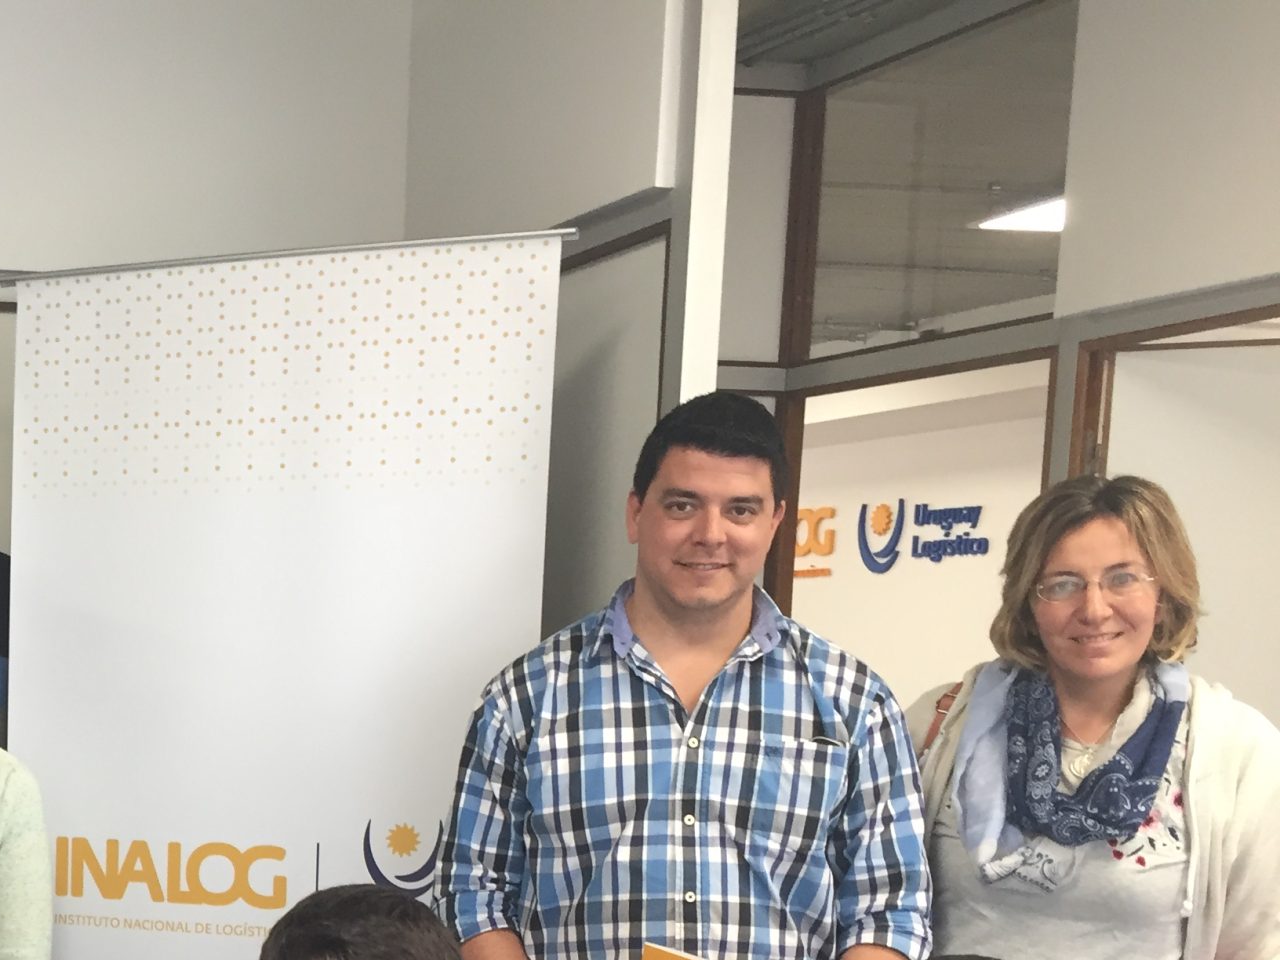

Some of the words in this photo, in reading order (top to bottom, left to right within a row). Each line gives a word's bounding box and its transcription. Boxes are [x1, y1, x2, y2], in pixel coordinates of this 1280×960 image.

[913, 504, 983, 530] Uruguay
[55, 836, 288, 909] INALOG
[54, 913, 121, 928] INSTITUTO
[123, 918, 191, 933] NACIONAL
[195, 922, 213, 935] DE
[216, 922, 270, 938] LOGÍSTI
